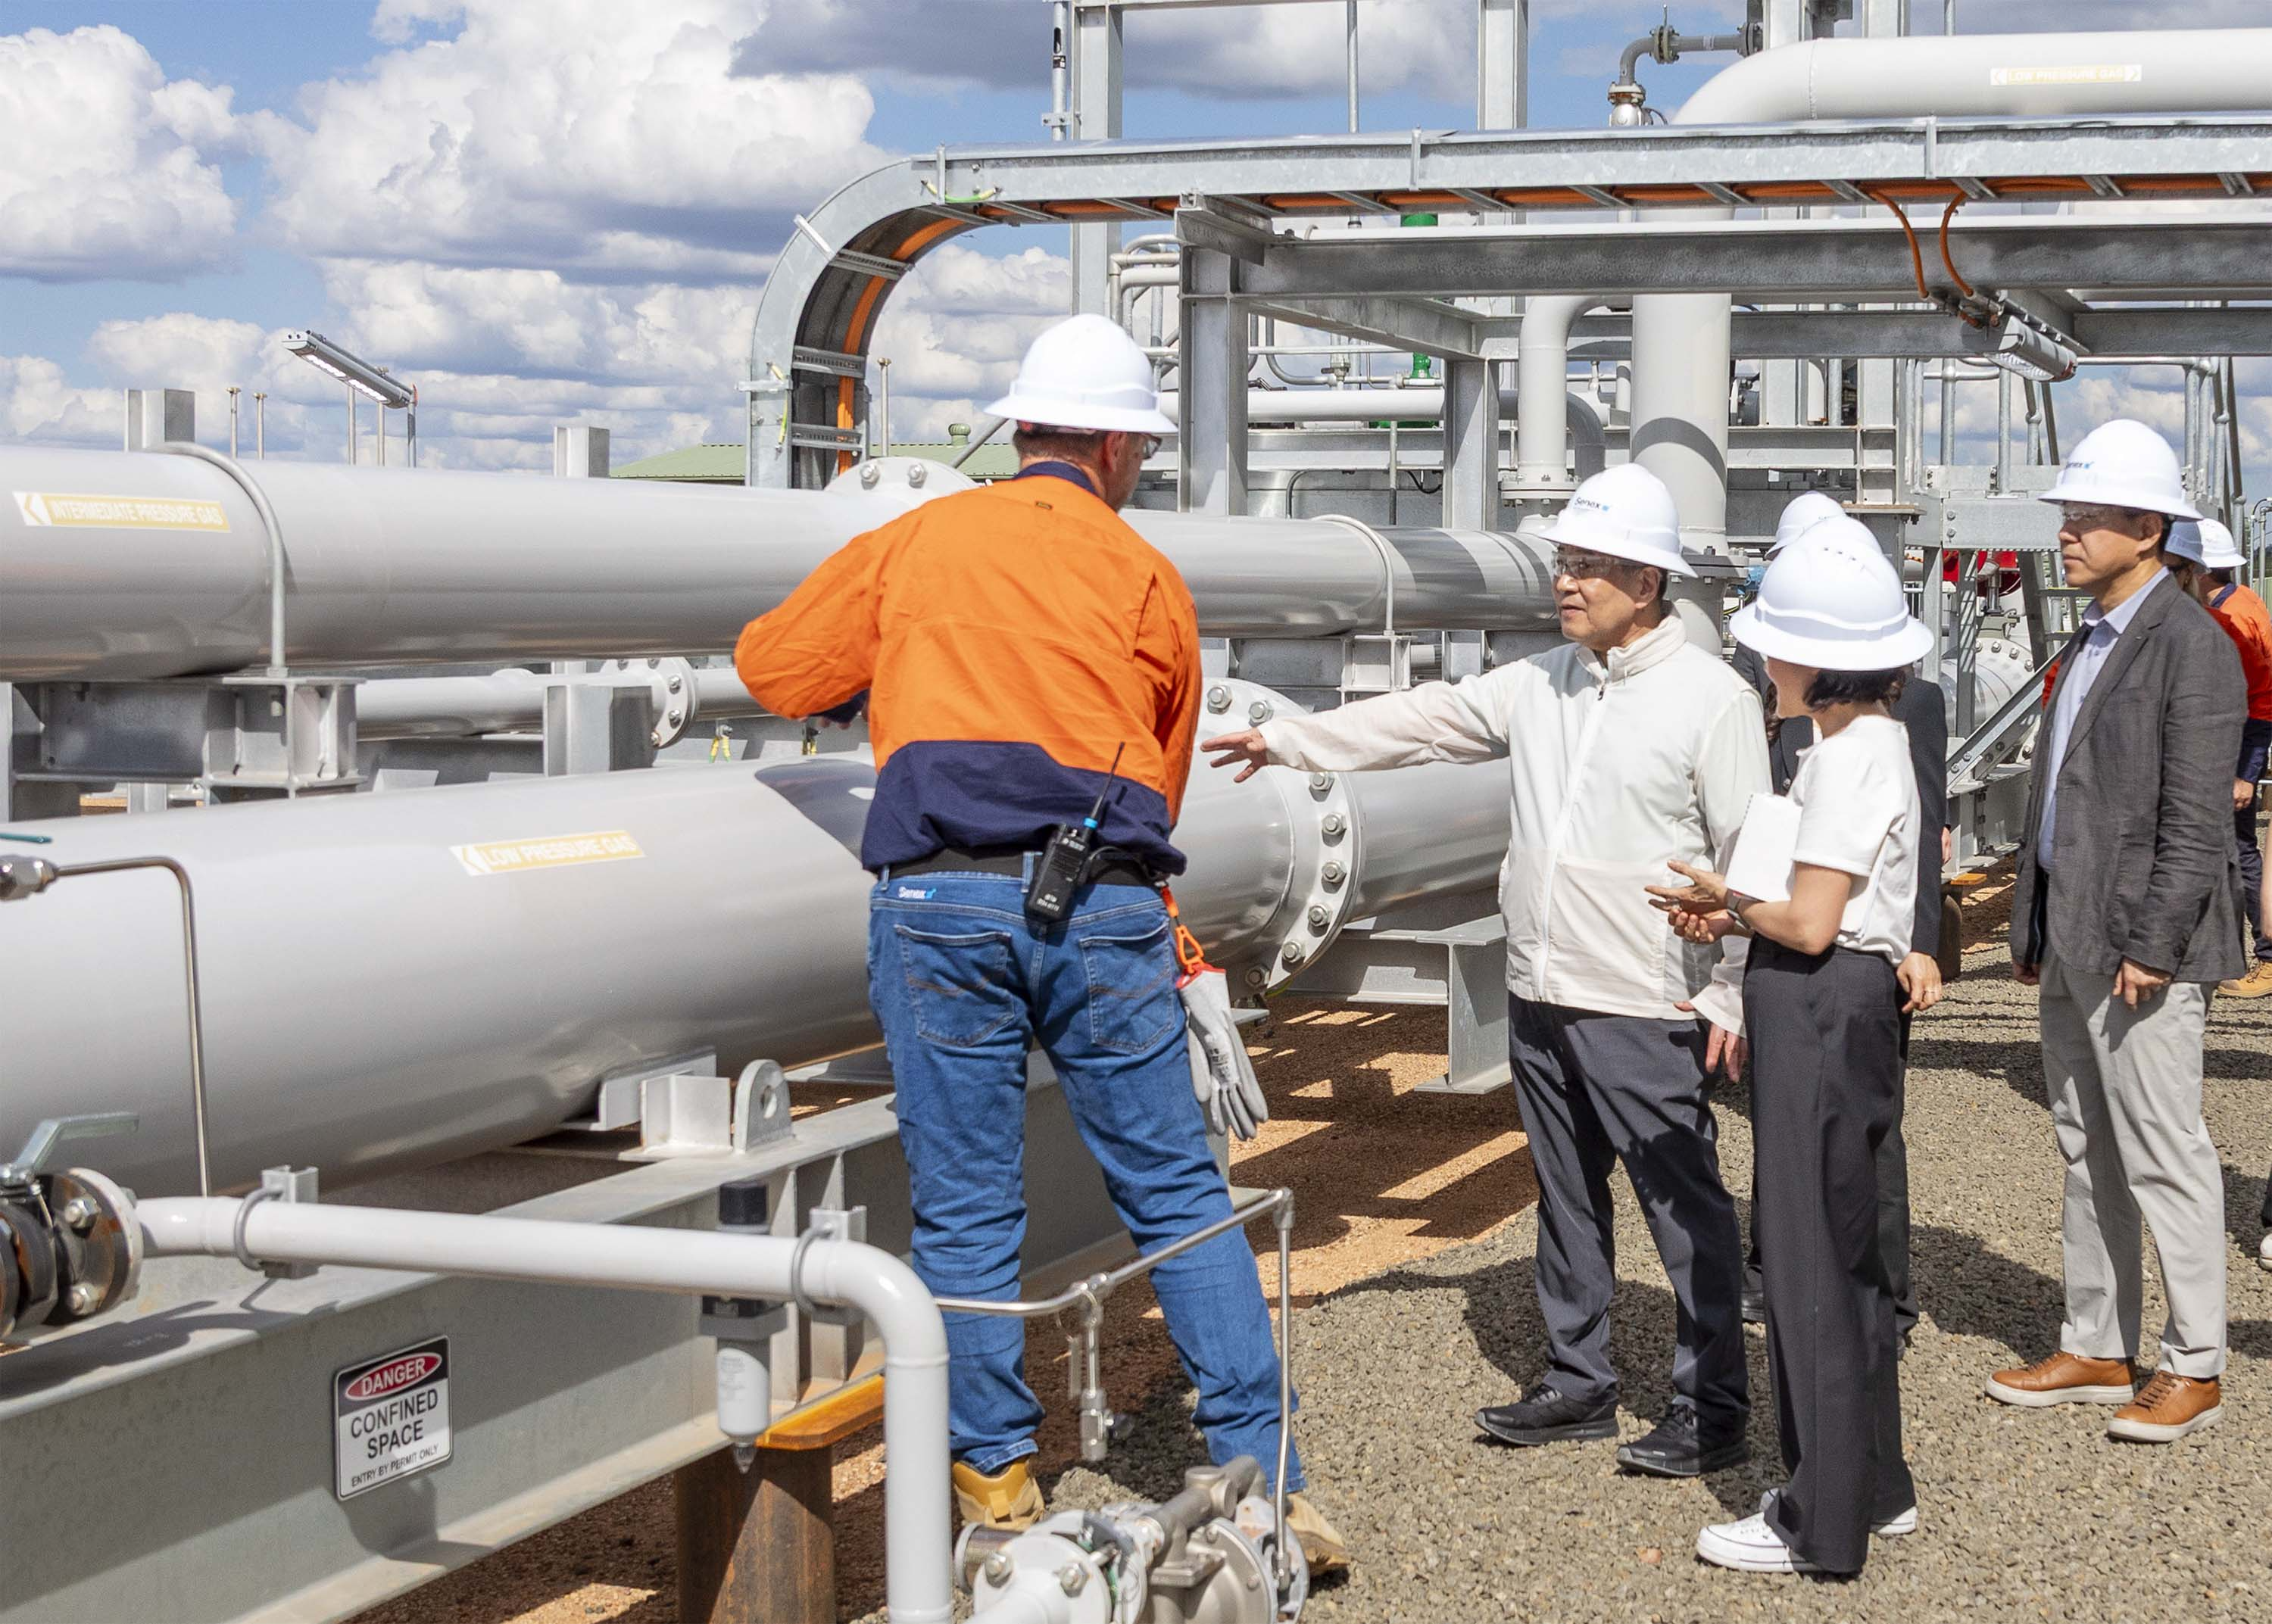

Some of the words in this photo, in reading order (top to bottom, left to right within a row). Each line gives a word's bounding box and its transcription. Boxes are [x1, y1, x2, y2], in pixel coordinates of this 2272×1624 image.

[49, 500, 138, 521] INTERMEDIATE
[136, 503, 198, 523] PRESSURE
[197, 507, 224, 525] GAS
[483, 847, 522, 865] LOW
[520, 838, 603, 862] PRESSURE
[601, 834, 638, 853] GAS
[362, 1357, 426, 1396] DANGER
[351, 1389, 438, 1439] CONFINED
[367, 1420, 424, 1459] SPACE
[351, 1469, 379, 1488] ENTRY
[378, 1462, 389, 1477] BY
[390, 1453, 417, 1472] PERMIT
[420, 1444, 439, 1460] ONLY
